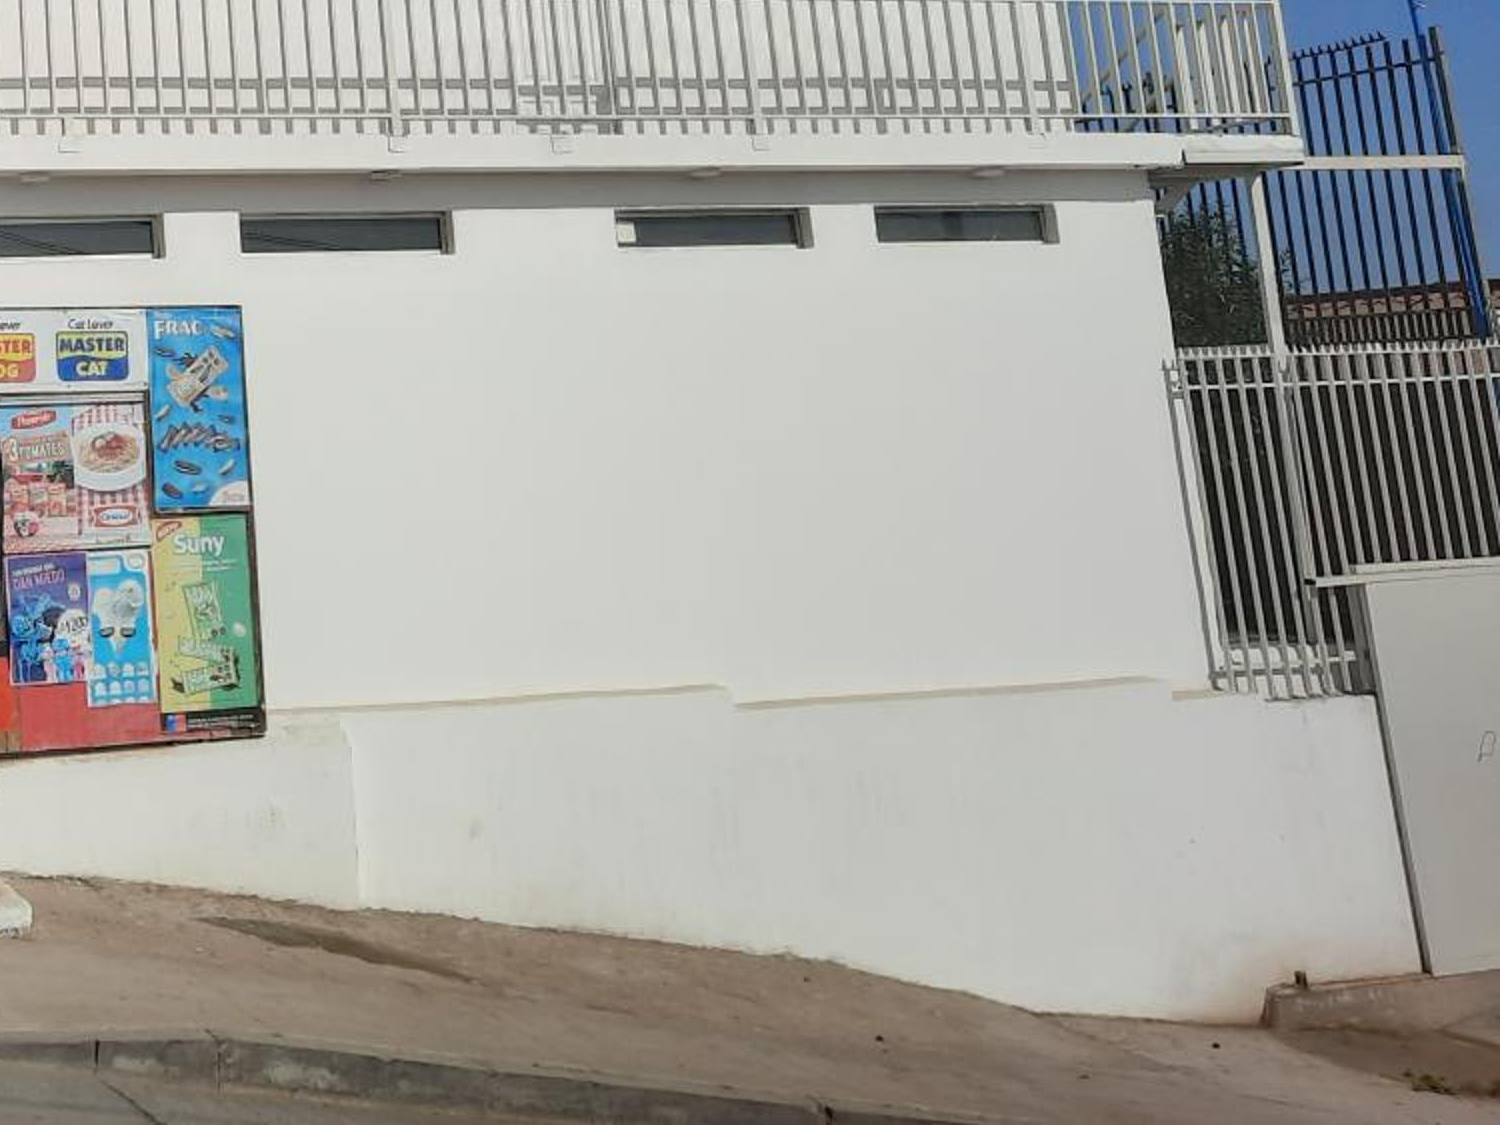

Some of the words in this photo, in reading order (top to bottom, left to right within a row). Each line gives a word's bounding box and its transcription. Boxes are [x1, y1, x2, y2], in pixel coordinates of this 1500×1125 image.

[59, 337, 125, 353] MASTER
[75, 362, 108, 377] CAT
[173, 533, 224, 556] Suny
